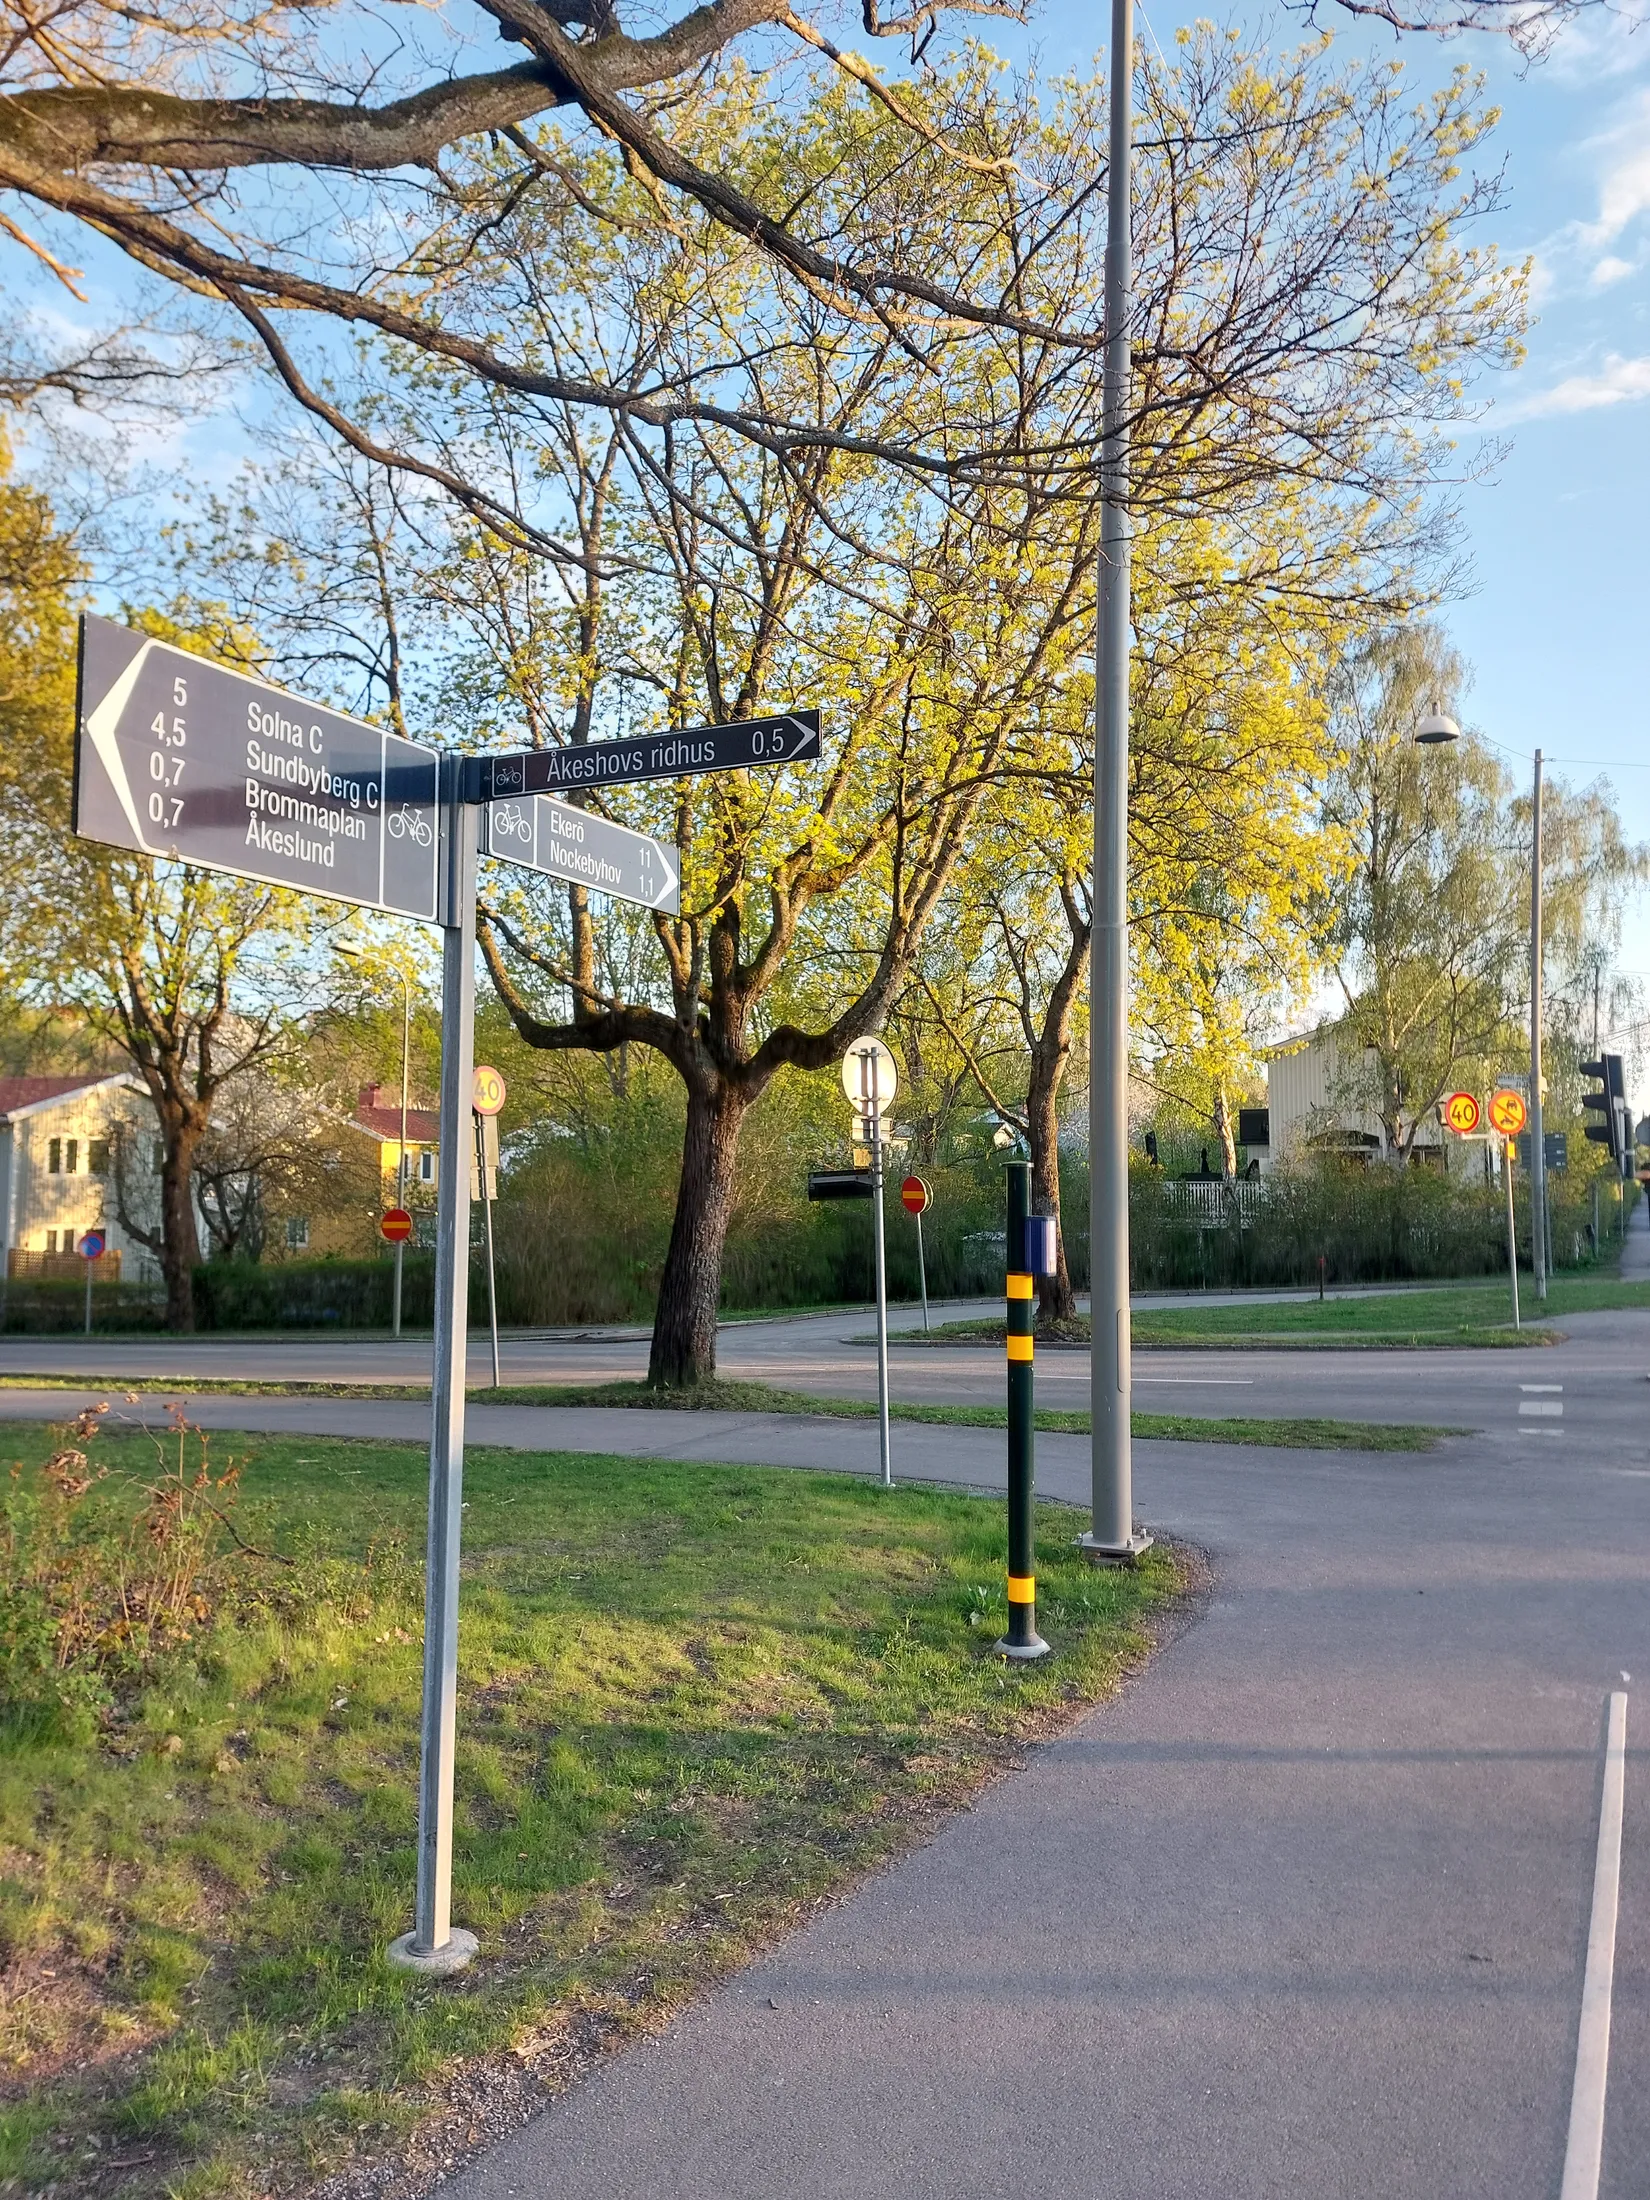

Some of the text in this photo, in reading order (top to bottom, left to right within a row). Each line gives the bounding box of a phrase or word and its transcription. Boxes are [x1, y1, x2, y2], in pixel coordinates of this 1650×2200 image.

[172, 676, 323, 755] 5 Solna C
[150, 711, 379, 810] 4,5 Sundbyberg C
[547, 728, 784, 782] Åkeshovs ridhus 0,5
[149, 751, 366, 842] 0,7 Brommaplan
[148, 792, 334, 868] 0,7 Åkeslund
[550, 810, 651, 868] Ekerö 11
[550, 839, 654, 896] Nockebyhov 1,1
[475, 1079, 499, 1101] 40
[1452, 1104, 1474, 1123] 40
